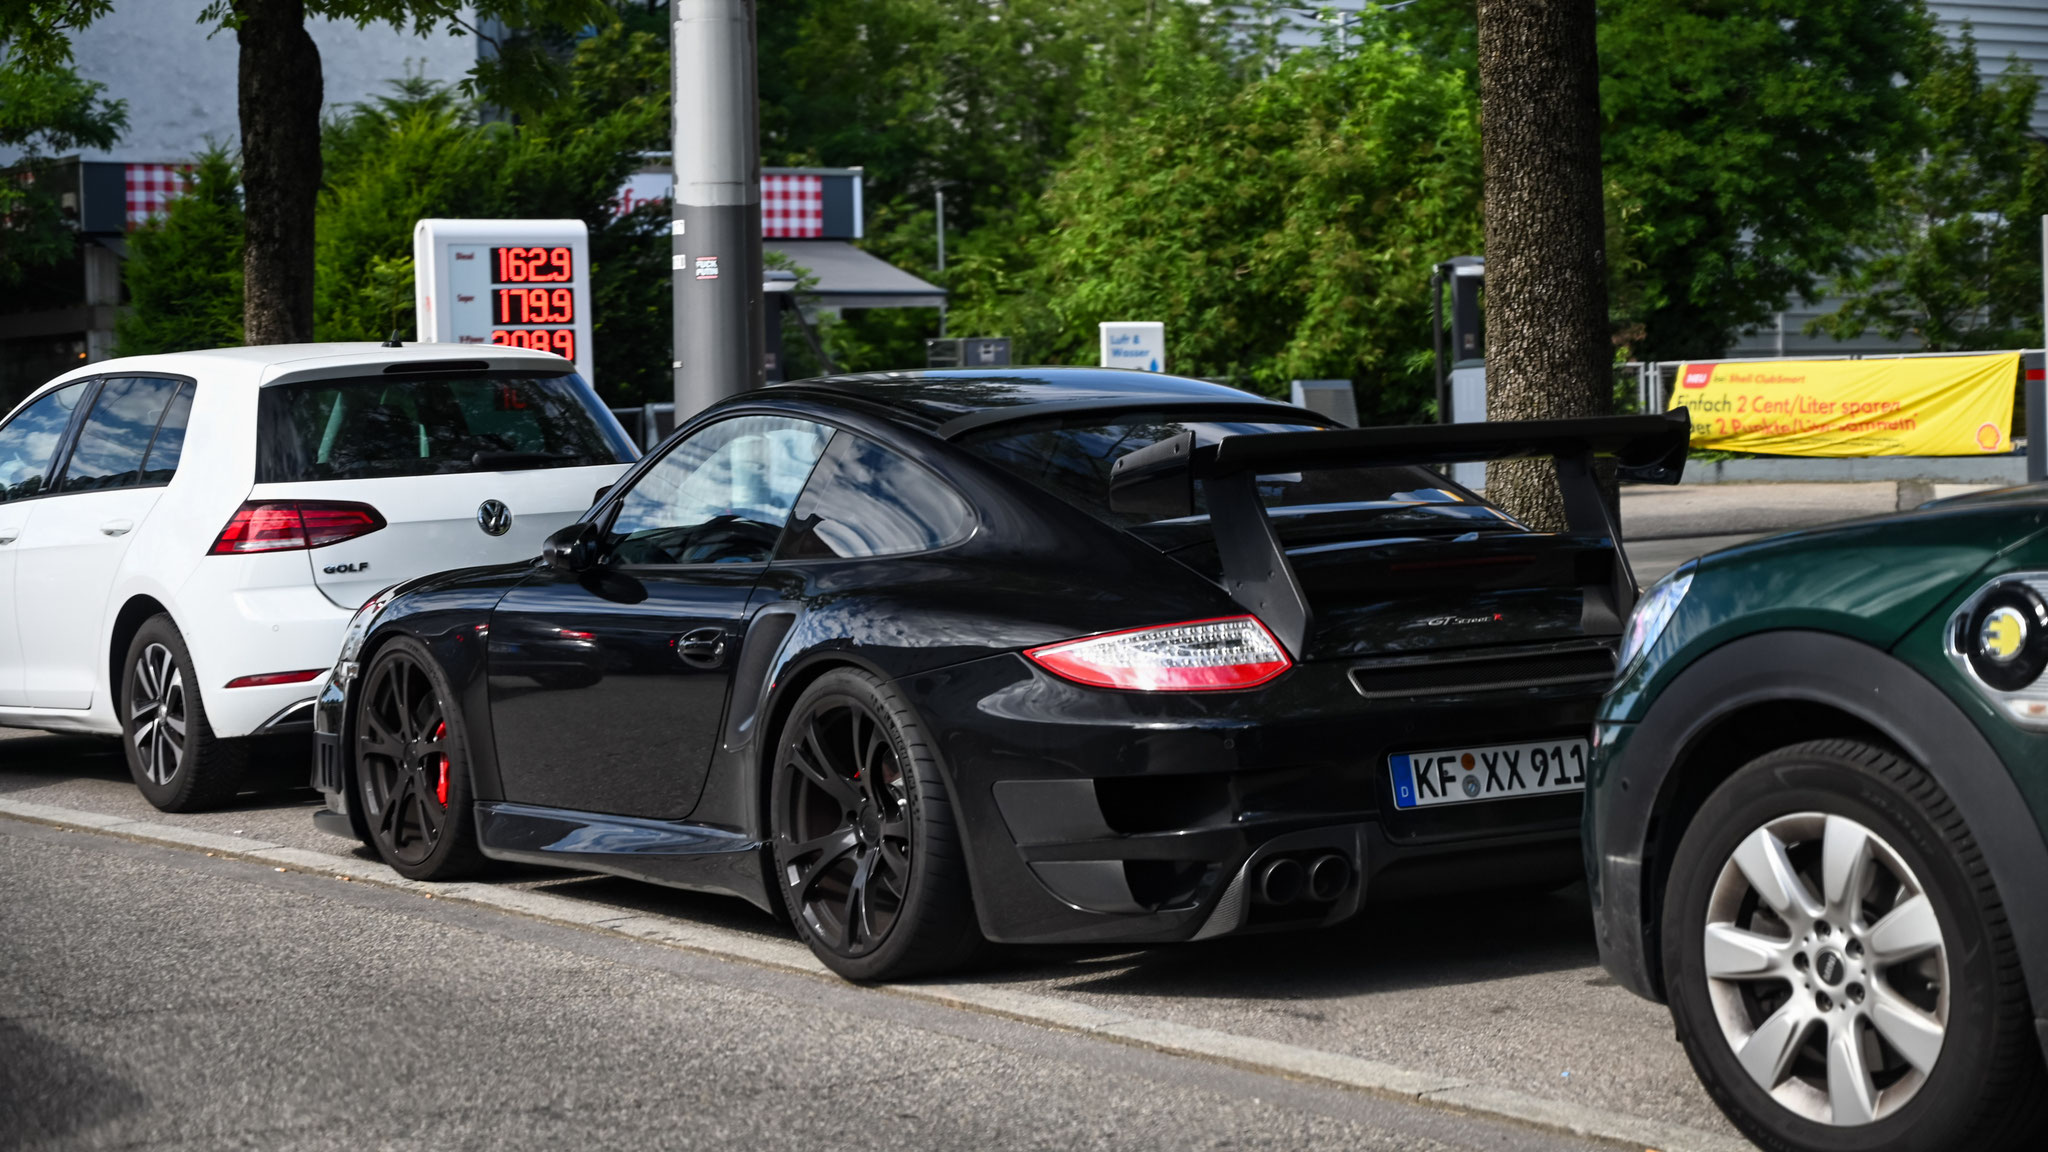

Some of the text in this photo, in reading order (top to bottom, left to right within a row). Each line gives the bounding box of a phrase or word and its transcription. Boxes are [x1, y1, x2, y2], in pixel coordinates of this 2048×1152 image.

[1737, 395, 1748, 413] 2
[1752, 394, 1837, 417] Cent/Liter
[1841, 400, 1902, 418] sparen
[1716, 418, 1729, 435] 2
[323, 562, 369, 574] GOLF
[1401, 744, 1586, 799] D KF XX 911
